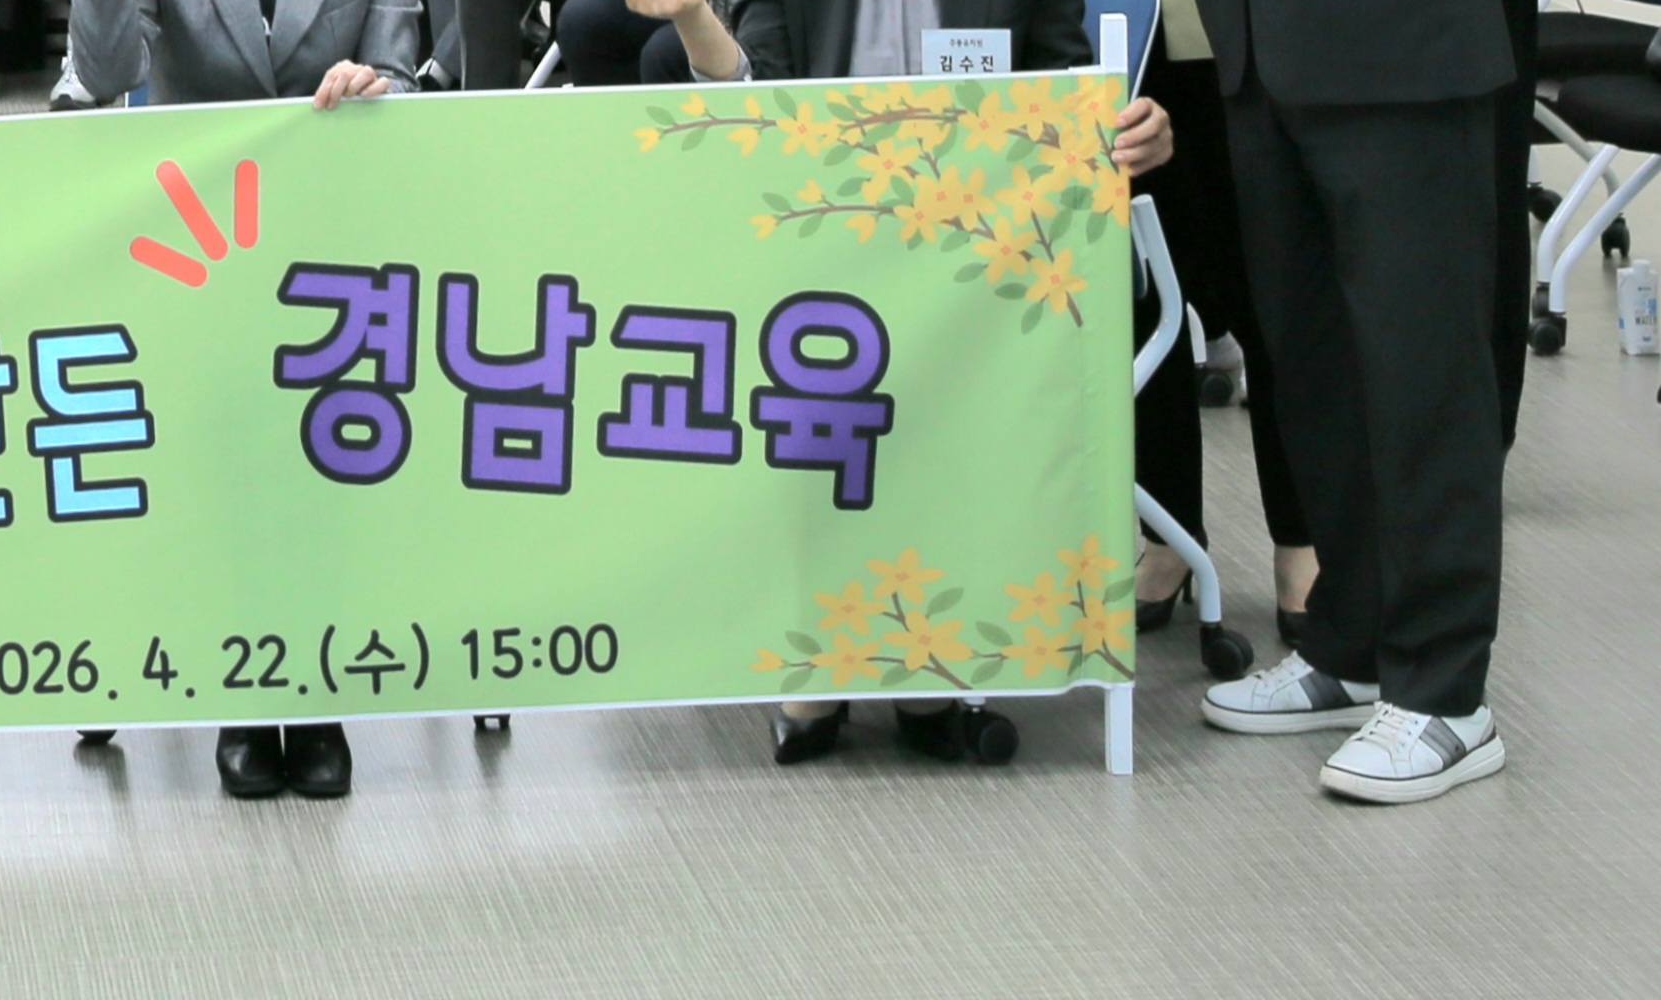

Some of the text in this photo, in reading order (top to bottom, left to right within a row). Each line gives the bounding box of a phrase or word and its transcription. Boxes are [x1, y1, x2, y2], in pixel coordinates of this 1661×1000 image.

[939, 55, 995, 74] 김수진
[273, 261, 894, 509] 경남교육
[143, 636, 196, 699] 4.
[462, 622, 621, 680] 15:00
